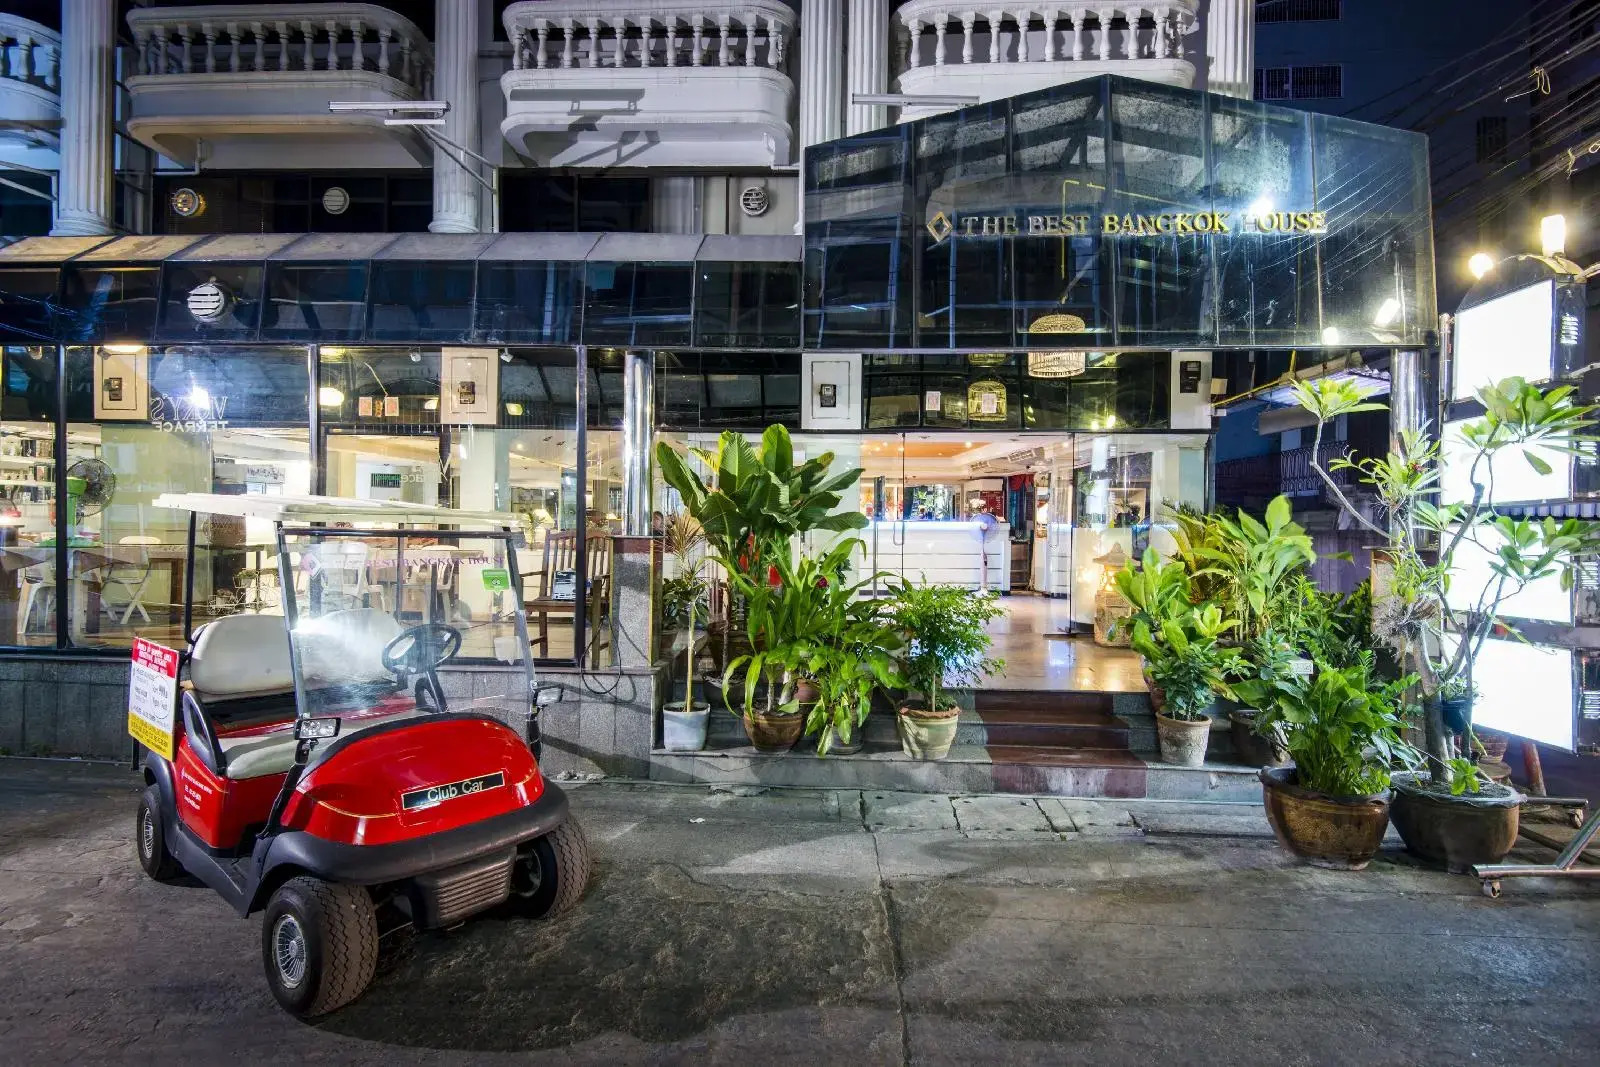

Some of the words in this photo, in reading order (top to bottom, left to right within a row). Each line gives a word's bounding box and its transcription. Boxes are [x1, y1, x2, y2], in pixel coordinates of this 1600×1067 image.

[961, 216, 1018, 236] THE
[1027, 215, 1090, 236] BEST
[1101, 213, 1229, 236] BANGKOK
[1240, 211, 1327, 234] HOUSE
[427, 785, 458, 802] Club
[461, 780, 484, 794] Car
